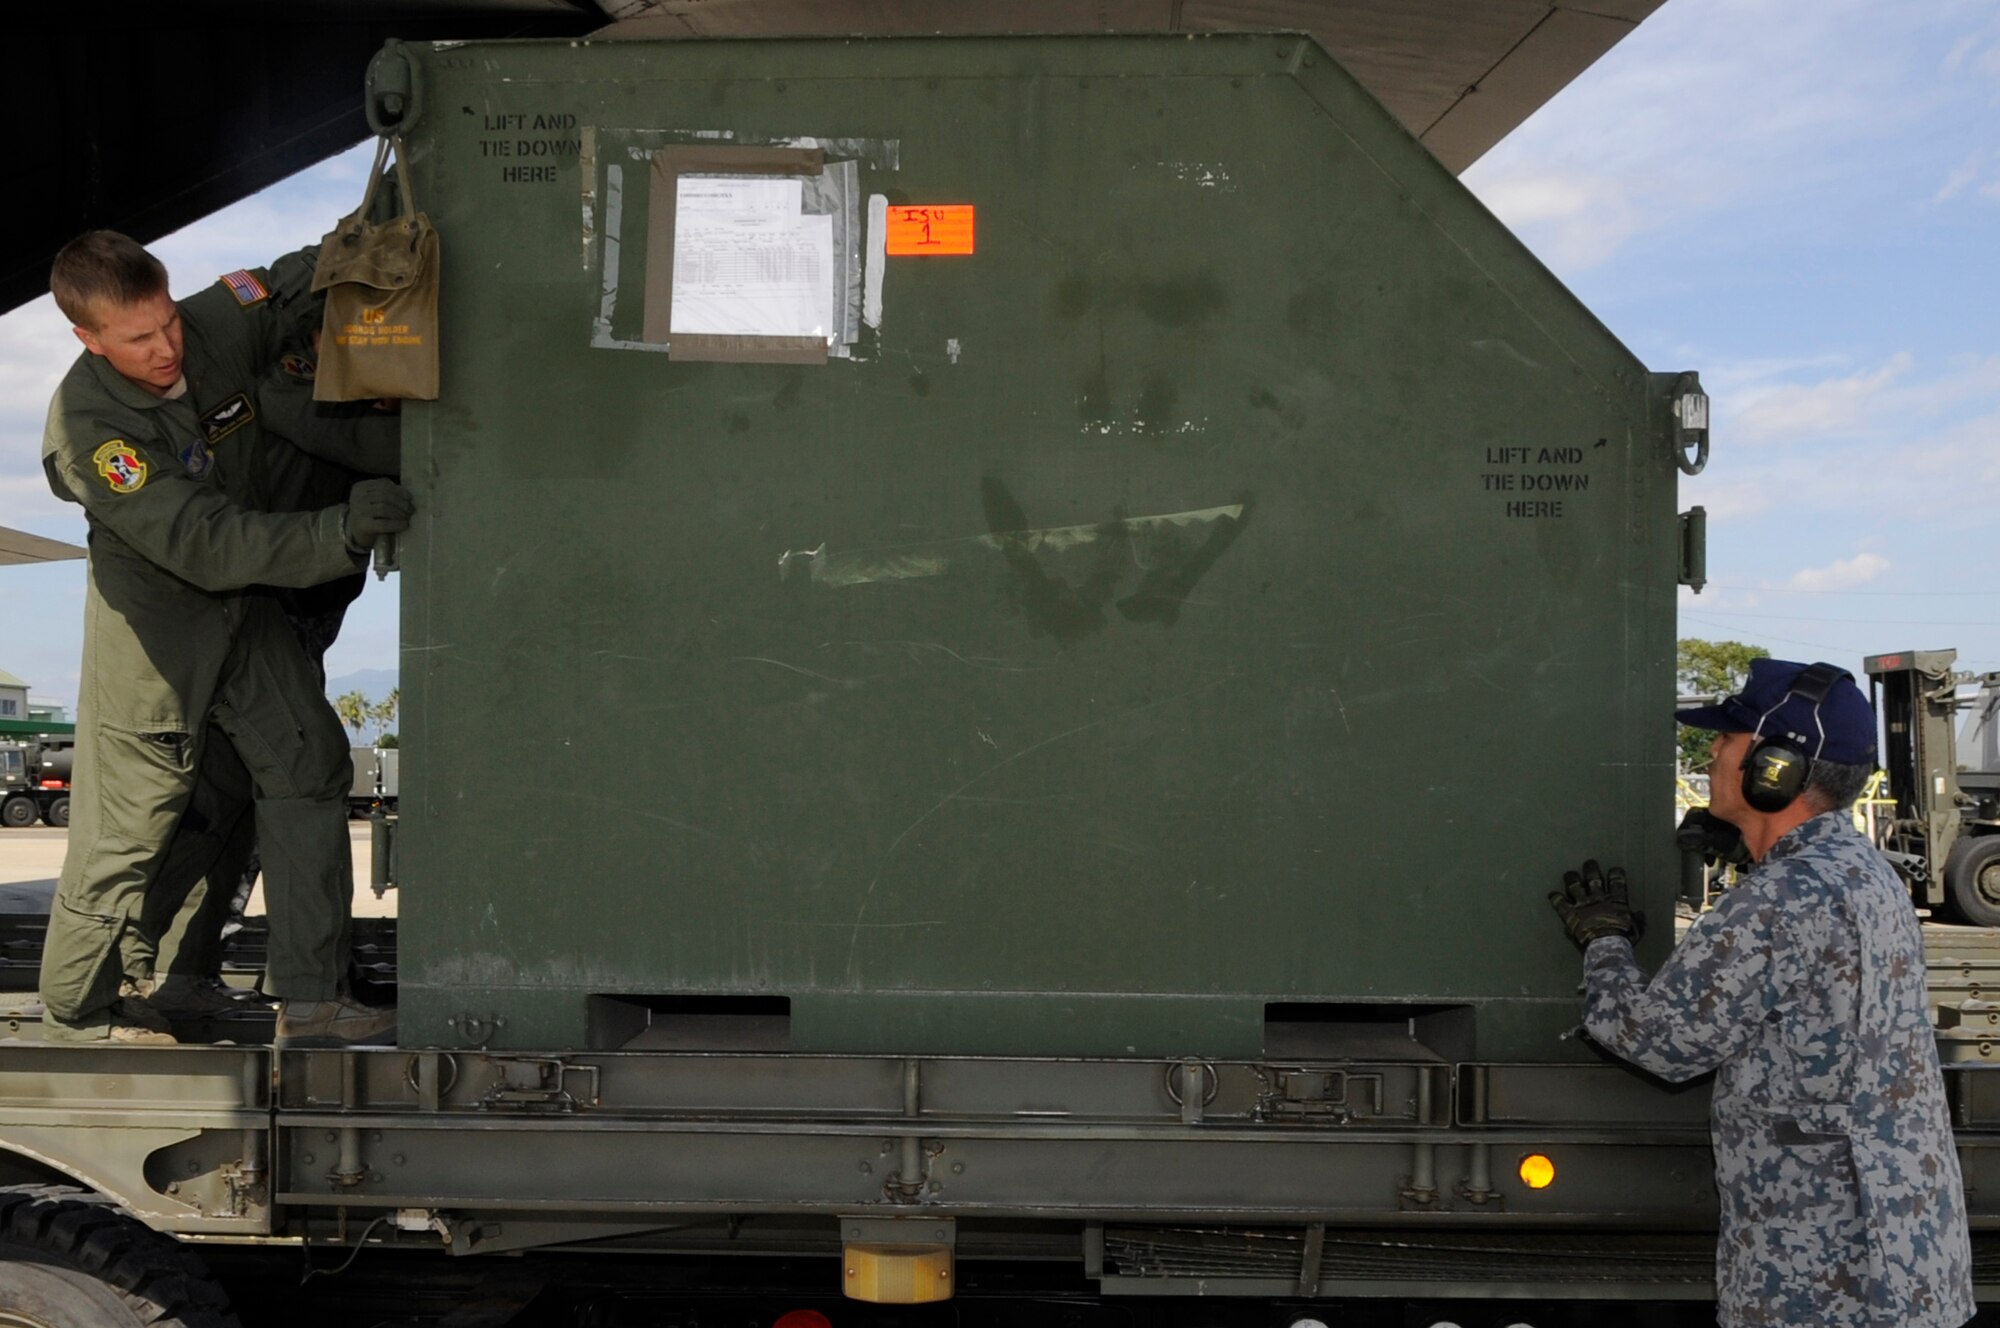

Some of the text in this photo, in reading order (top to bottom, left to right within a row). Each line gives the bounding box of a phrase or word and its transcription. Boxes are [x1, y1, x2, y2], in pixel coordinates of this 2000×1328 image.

[485, 114, 577, 131] LIFT AND
[480, 139, 582, 157] TIE DOWN
[503, 166, 557, 182] HERE
[916, 222, 941, 245] 1
[363, 308, 385, 324] US
[1487, 447, 1584, 464] LIFT AND
[1481, 474, 1590, 491] TIE DOWN
[1506, 501, 1563, 518] HERE
